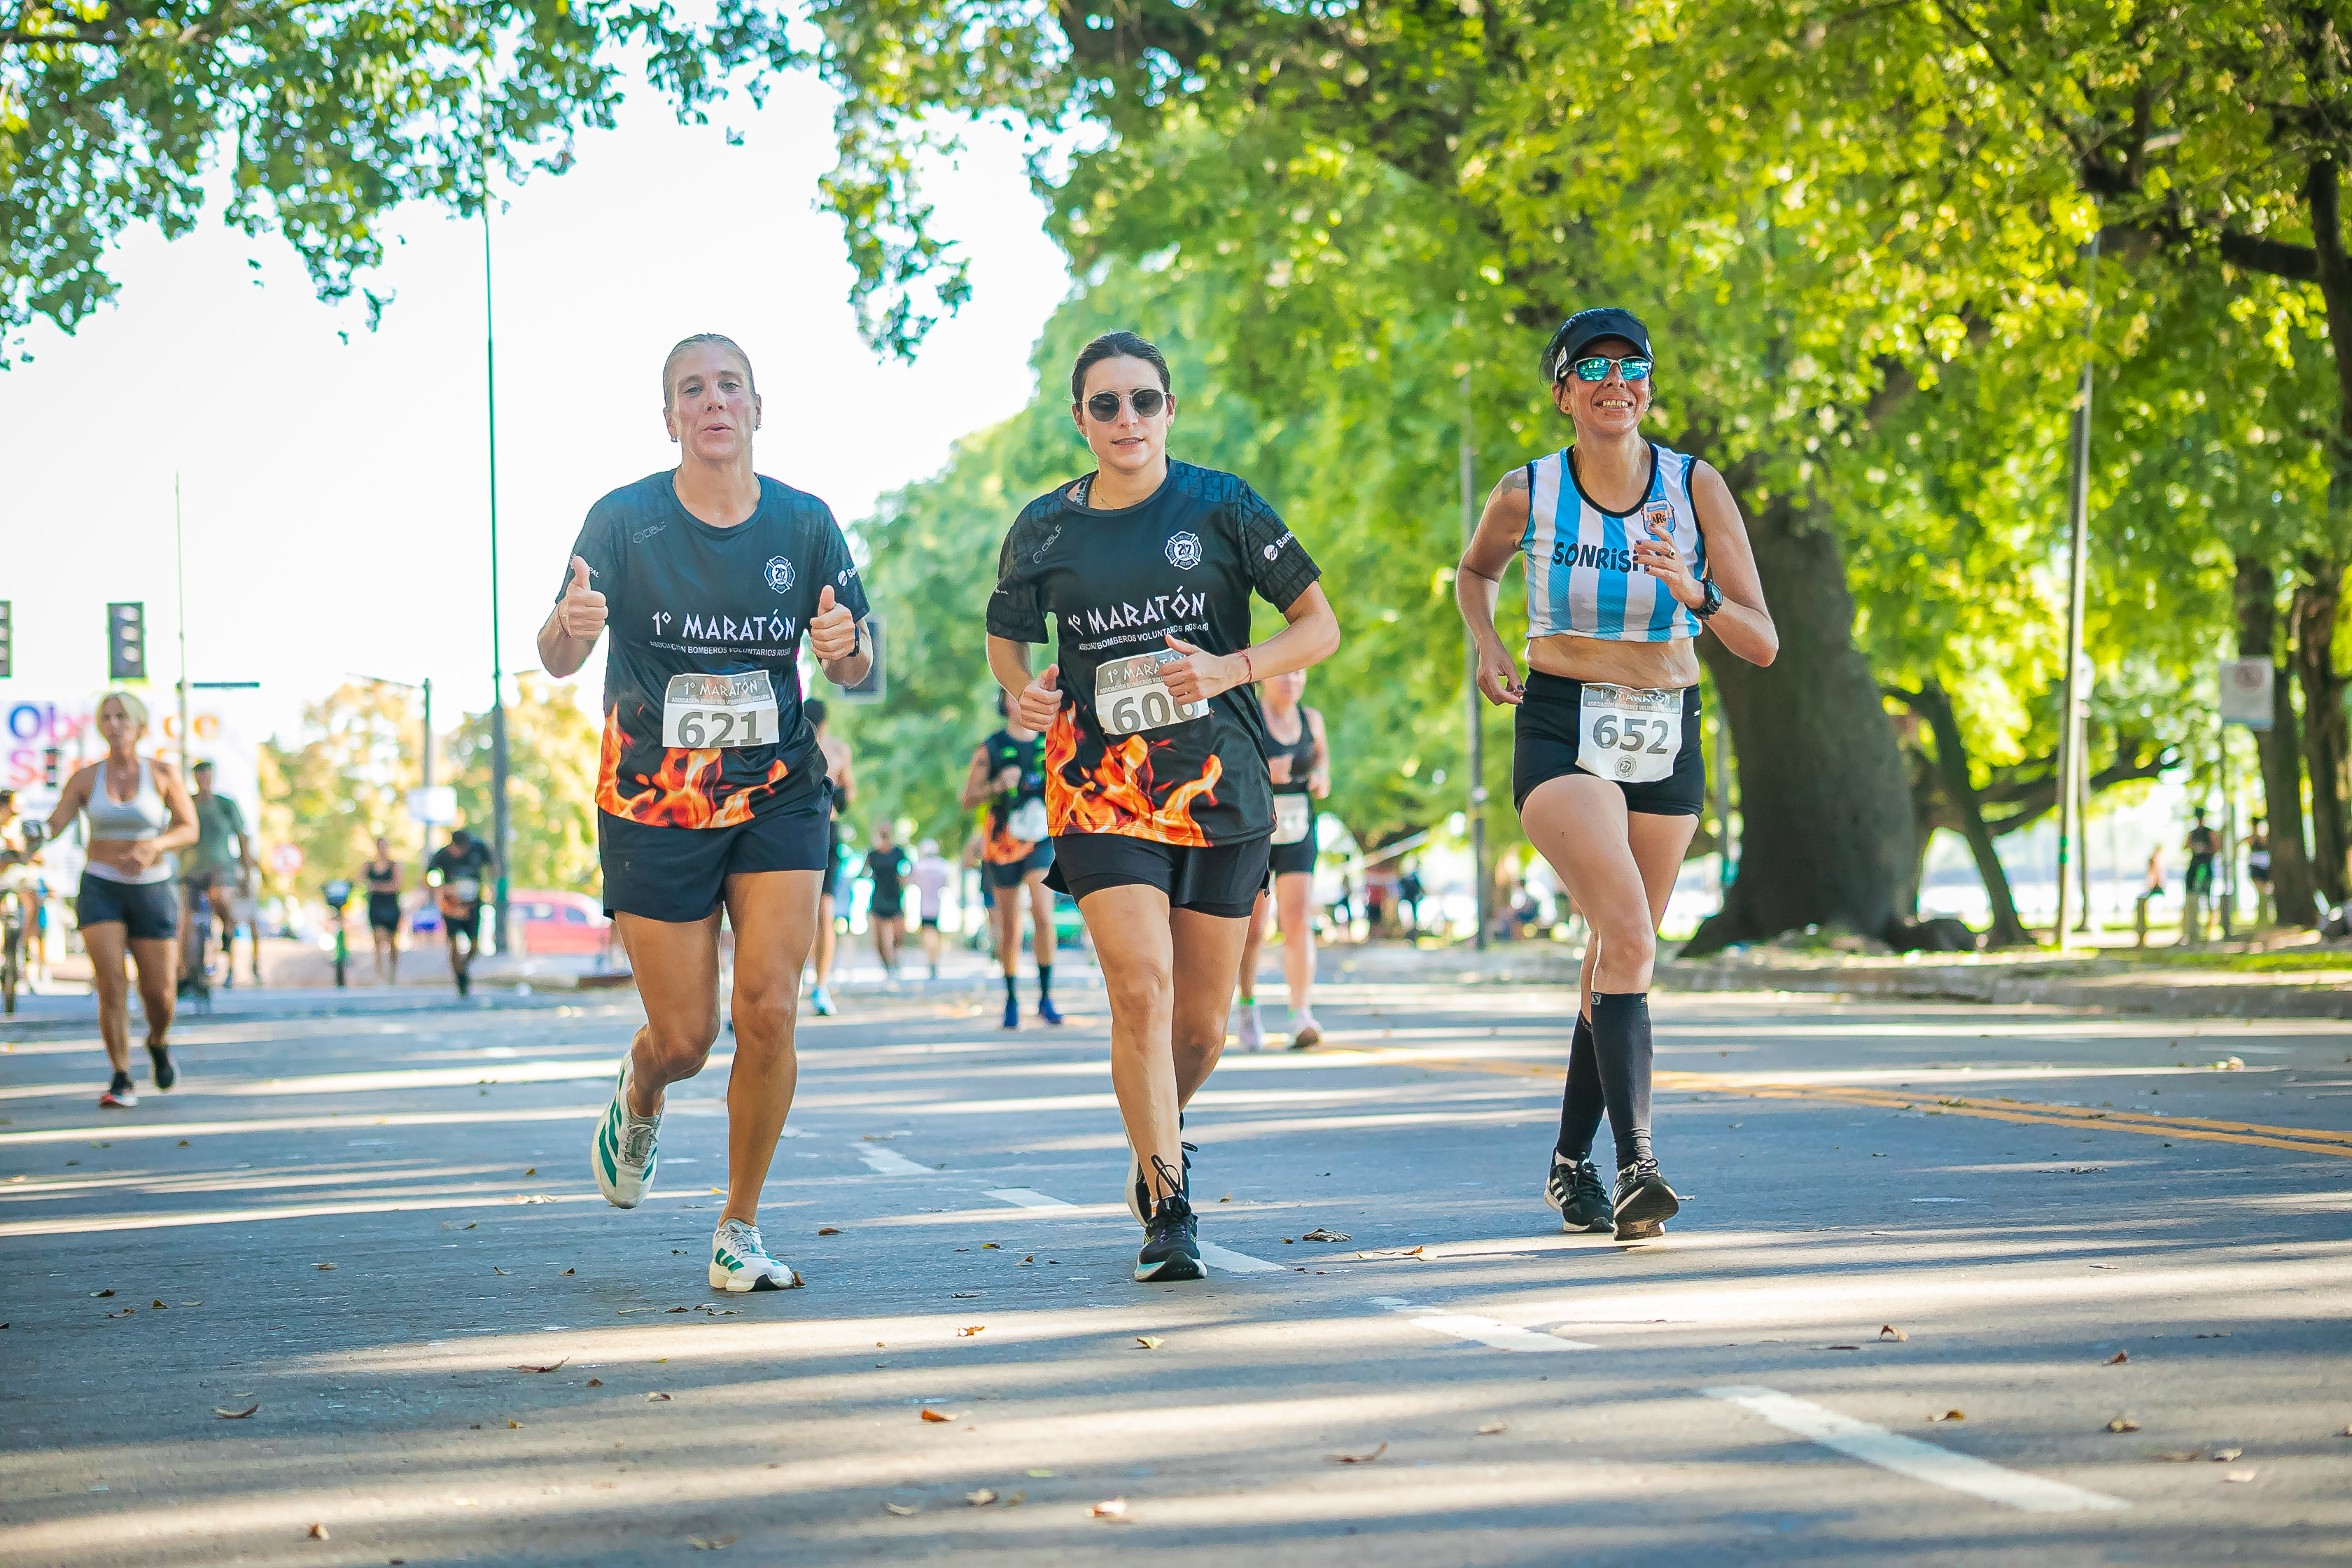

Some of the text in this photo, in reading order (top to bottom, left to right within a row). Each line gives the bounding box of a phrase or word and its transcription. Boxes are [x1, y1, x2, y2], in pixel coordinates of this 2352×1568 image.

[1653, 512, 1667, 524] ARG
[1086, 585, 1205, 634] MARATÓN
[682, 608, 796, 641] MARATÓN
[687, 645, 727, 654] BOMBEROS
[729, 648, 776, 657] VOLUNTARIOS
[1096, 634, 1137, 650] BOMBEROS
[699, 678, 758, 697] MARATÓN
[1100, 682, 1126, 694] ASOCIACIÓN
[1126, 678, 1152, 689] BOMBEROS
[678, 710, 762, 748] 621
[1593, 715, 1669, 754] 652
